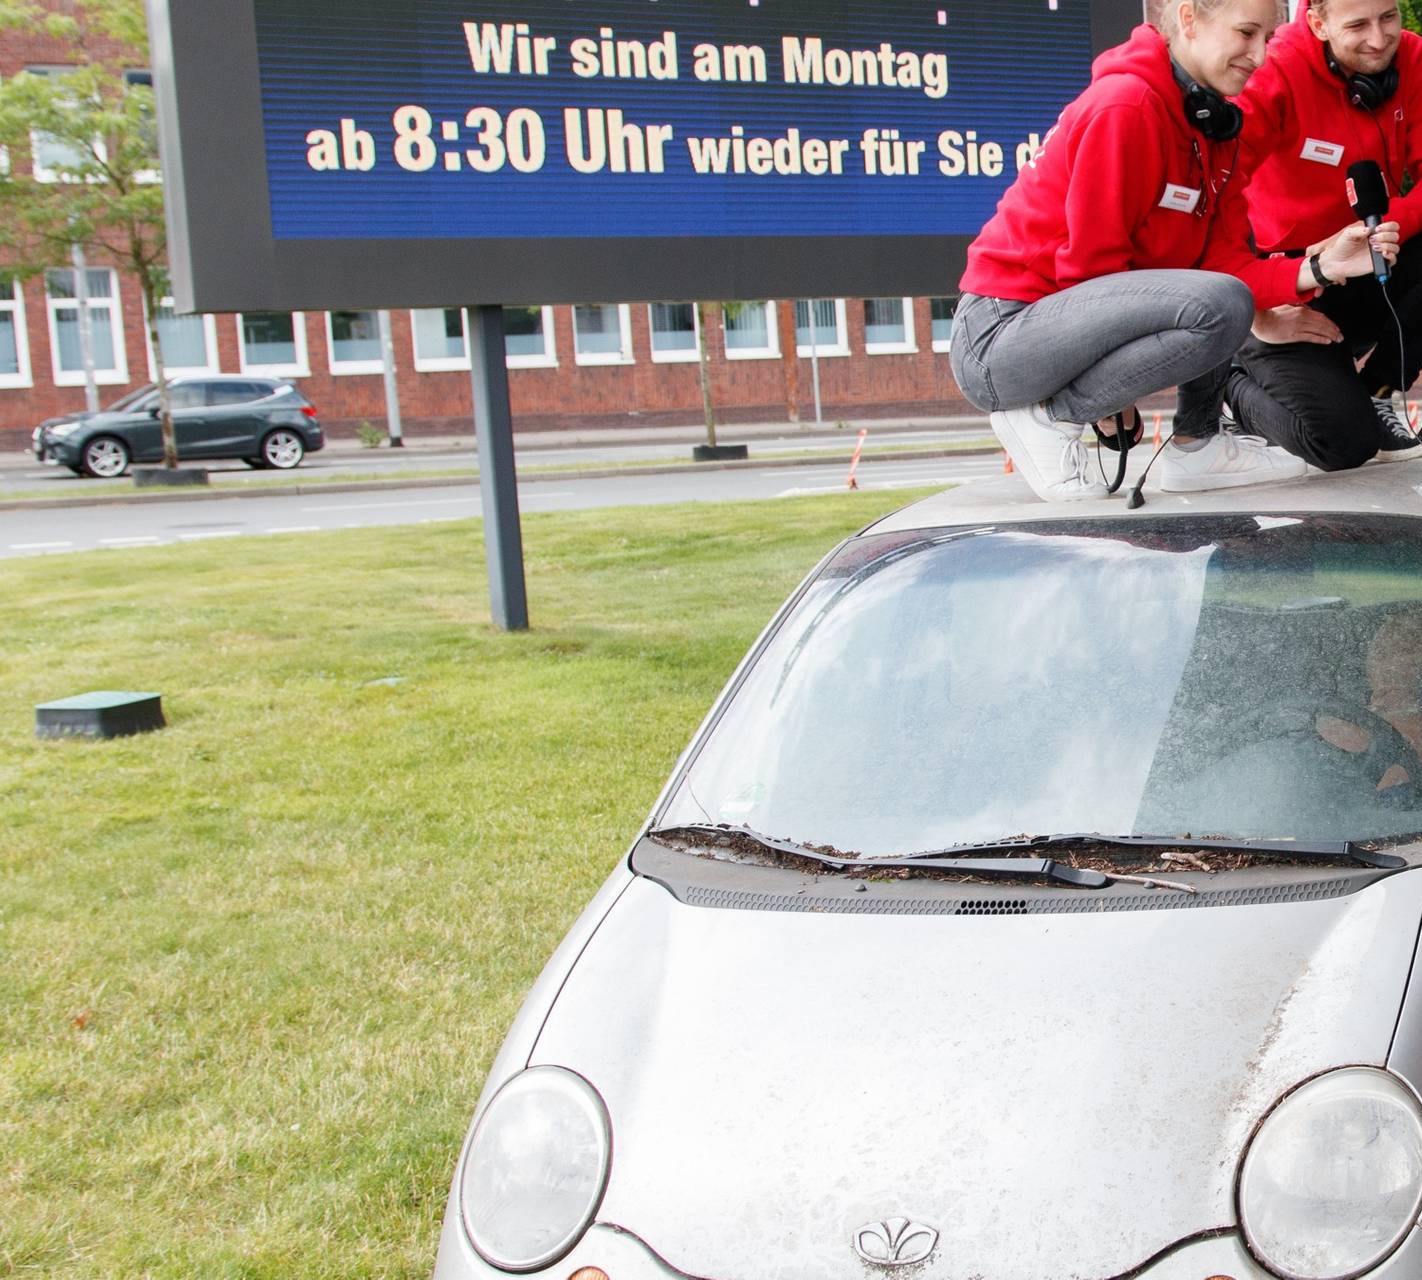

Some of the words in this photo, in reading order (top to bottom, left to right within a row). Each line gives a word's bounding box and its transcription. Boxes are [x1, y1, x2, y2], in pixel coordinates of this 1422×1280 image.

[463, 22, 556, 75] Wir
[570, 27, 678, 81] sind
[693, 43, 767, 82] am
[782, 36, 949, 99] Montag
[305, 118, 376, 172] ab
[393, 105, 546, 173] 8:30
[564, 107, 673, 174] Uhr
[686, 125, 849, 176] wieder
[859, 128, 926, 176] für
[937, 130, 1004, 177] Sie
